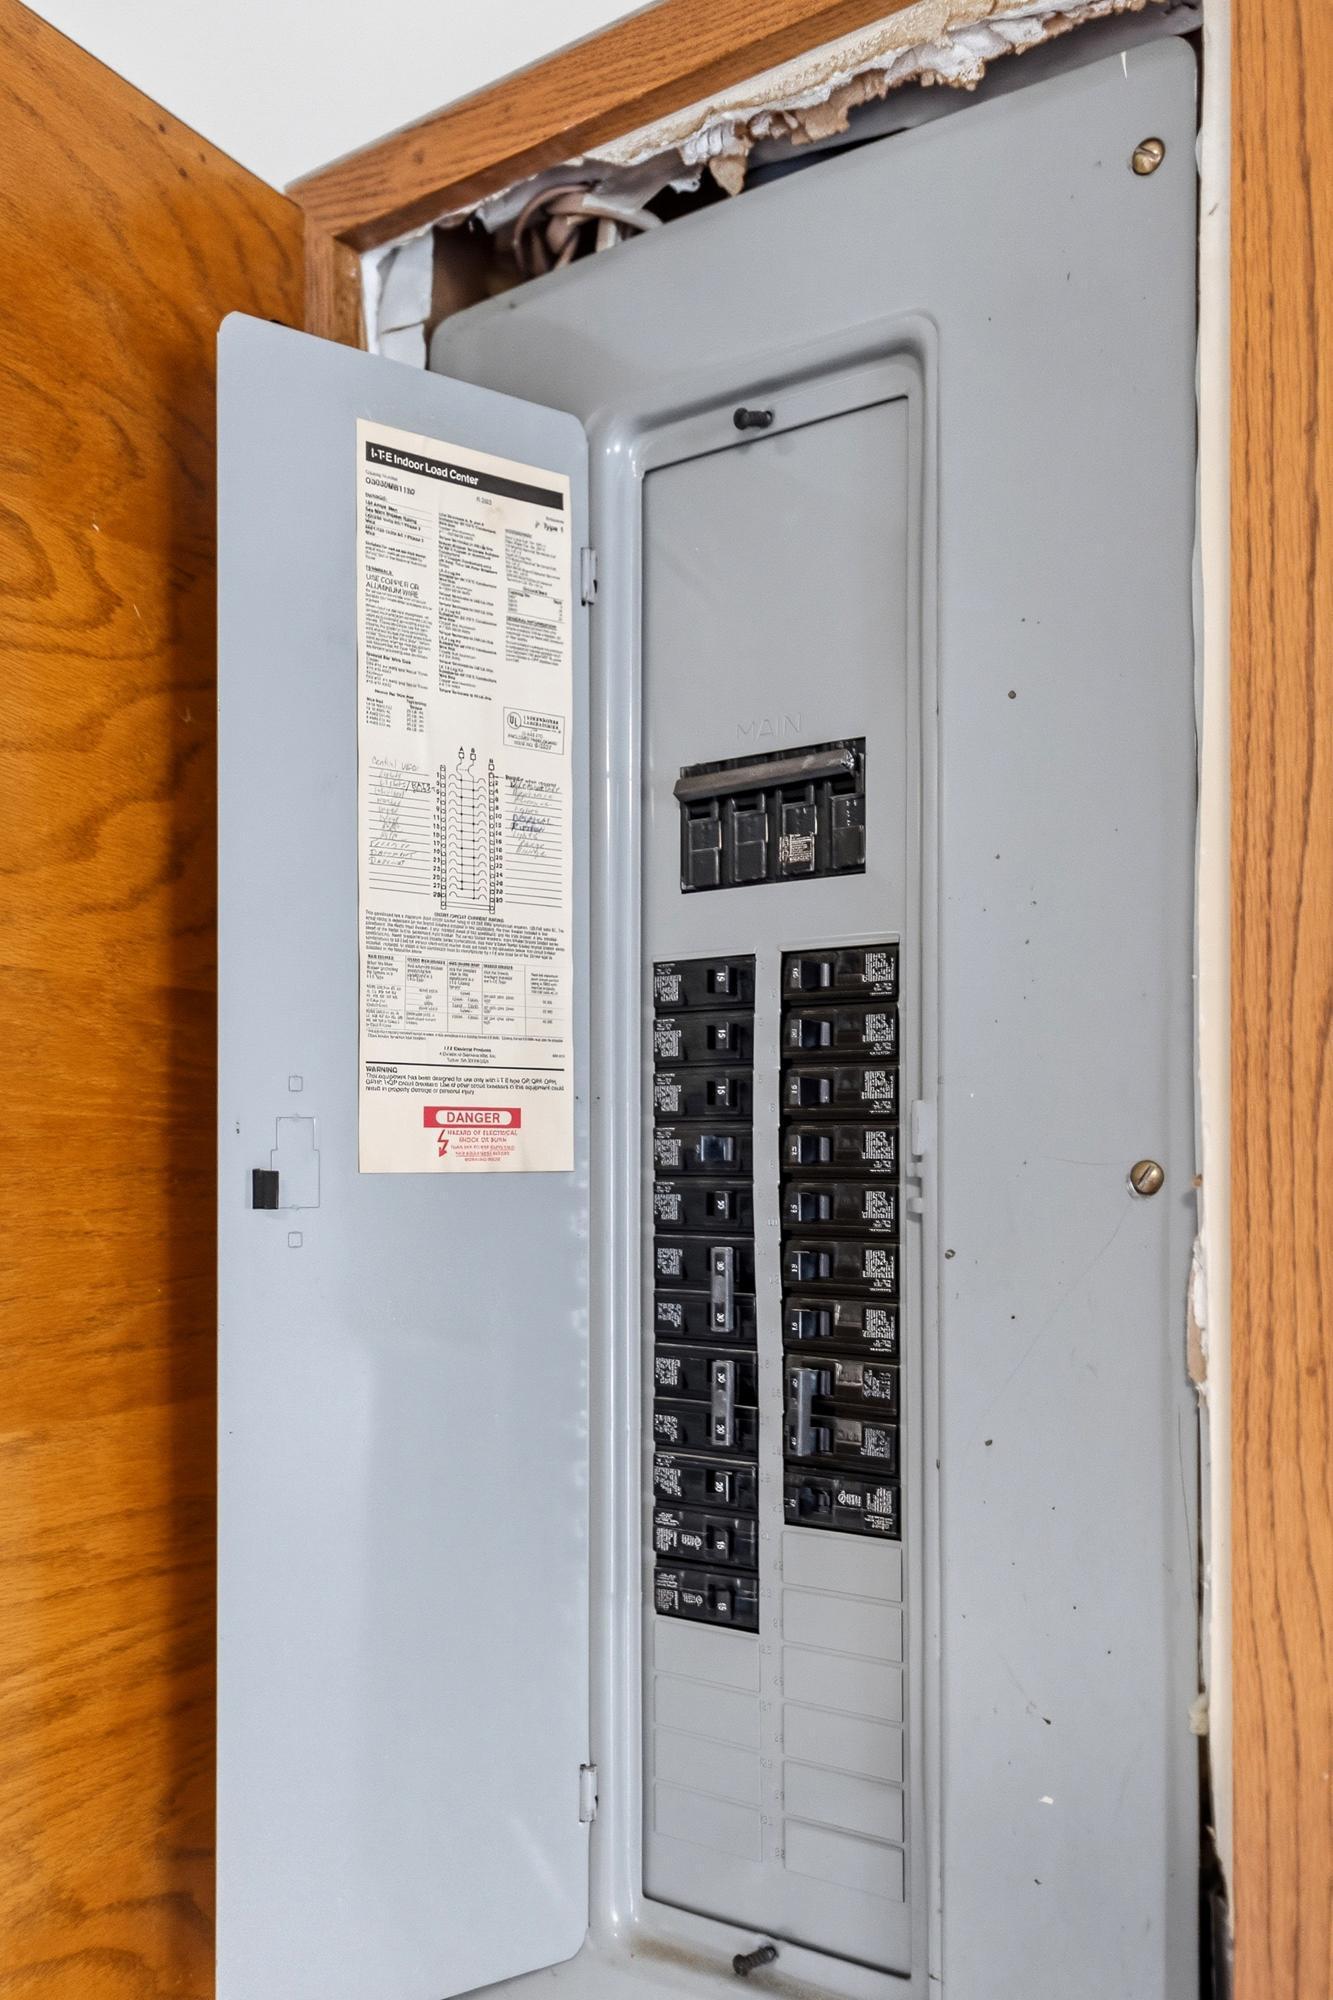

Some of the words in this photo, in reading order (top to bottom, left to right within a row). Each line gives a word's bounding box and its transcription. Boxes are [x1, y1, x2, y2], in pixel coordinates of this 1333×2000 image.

[393, 454, 424, 472] Indoor
[425, 462, 449, 478] Load
[449, 470, 479, 486] Center
[543, 521, 558, 532] Type
[736, 711, 802, 741] MAIN
[716, 972, 726, 982] 15
[717, 1029, 726, 1040] 15
[365, 1065, 398, 1074] WARNING
[366, 1072, 378, 1080] This
[378, 1074, 407, 1082] equipment
[432, 1075, 455, 1084] designed
[388, 1086, 409, 1094] property
[525, 1084, 551, 1092] equipment
[717, 1085, 726, 1095] 15
[446, 1111, 500, 1123] DANGER
[714, 1481, 724, 1493] 20
